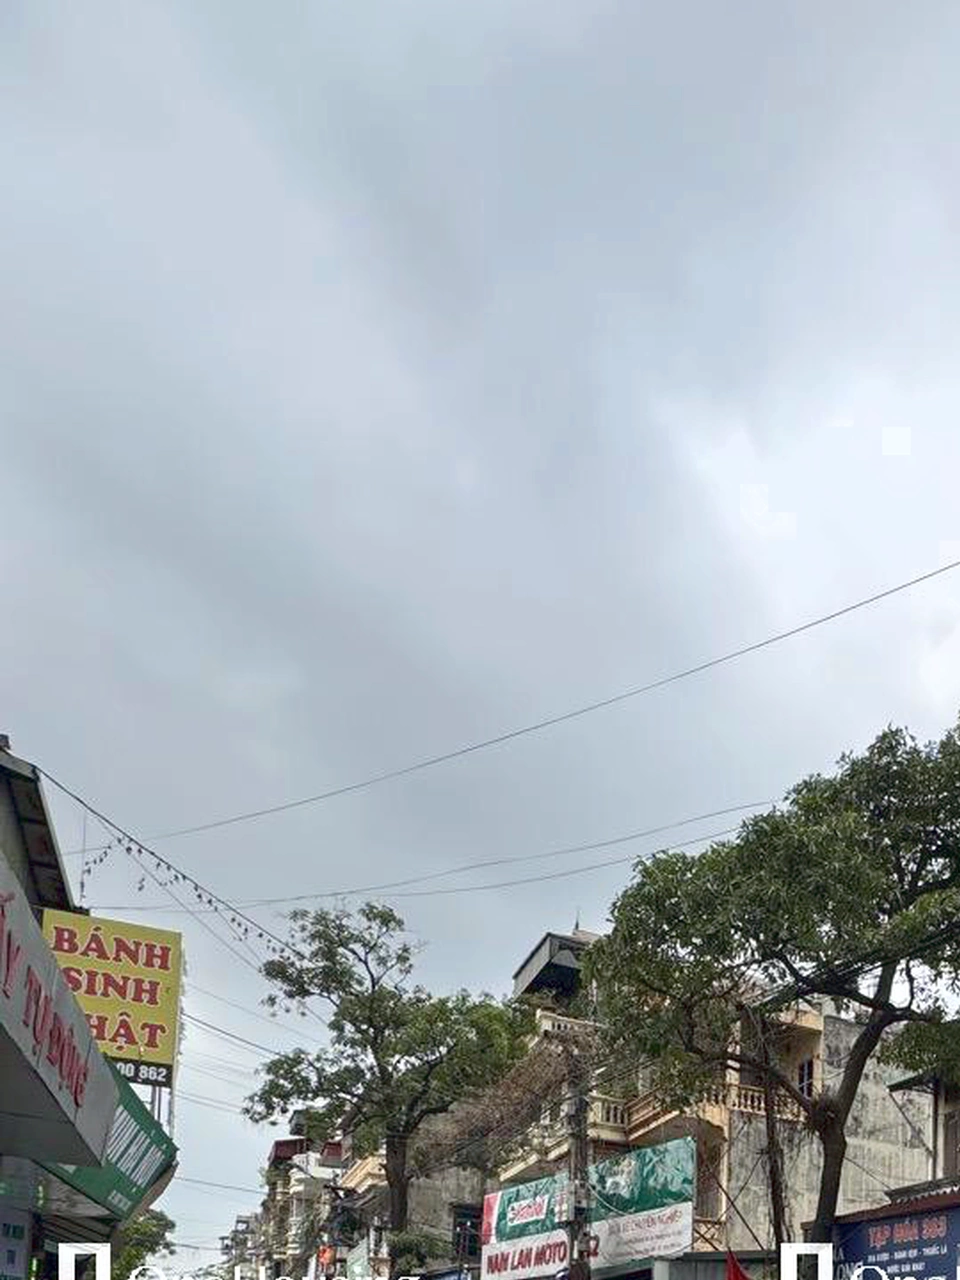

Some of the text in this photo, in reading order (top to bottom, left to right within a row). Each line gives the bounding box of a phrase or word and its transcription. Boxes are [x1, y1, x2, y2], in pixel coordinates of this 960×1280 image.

[52, 926, 171, 971] BÁNH
[61, 966, 161, 1006] SINH
[84, 1011, 167, 1051] HẬT
[138, 1064, 167, 1082] 862
